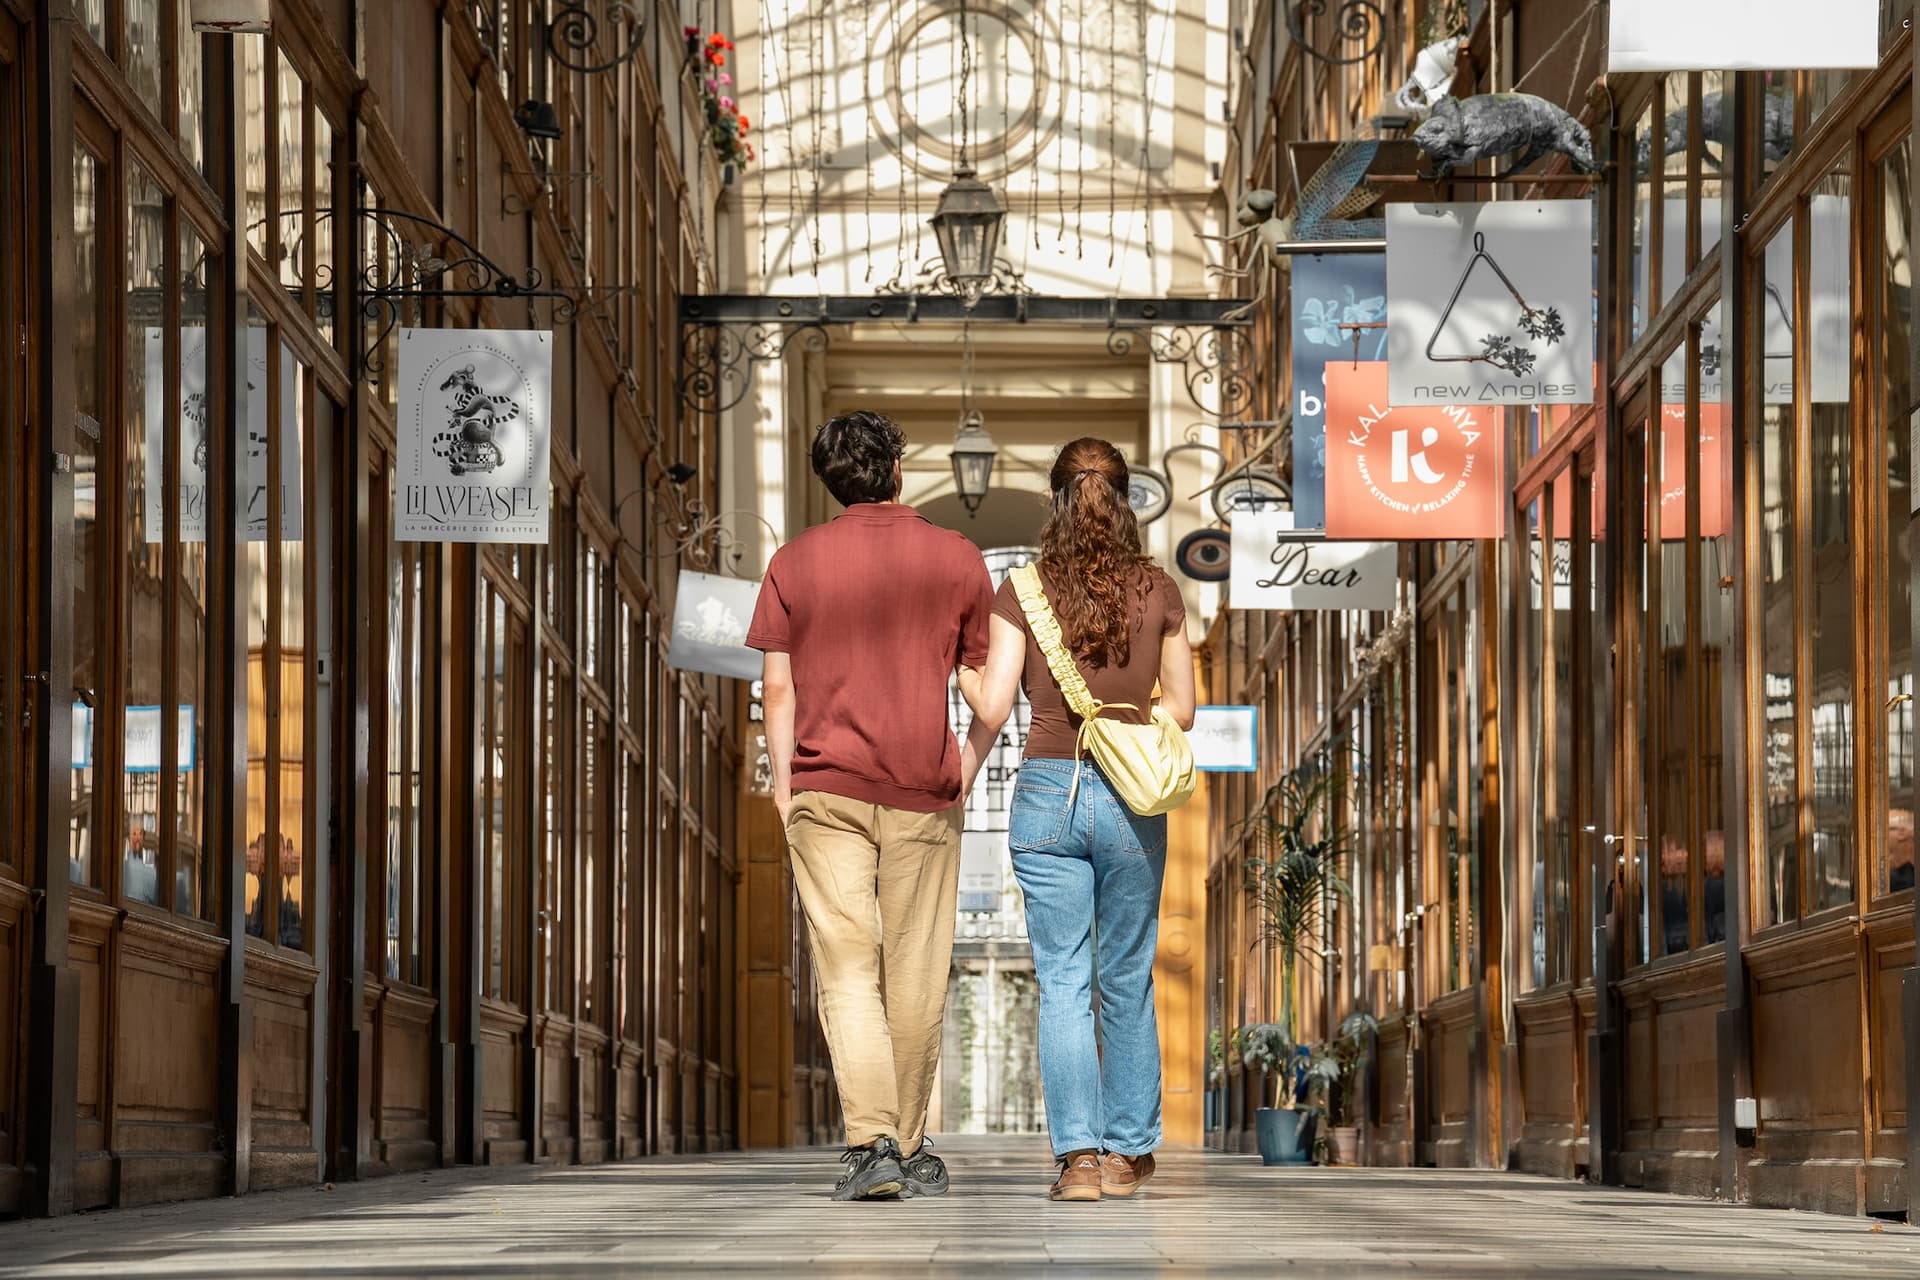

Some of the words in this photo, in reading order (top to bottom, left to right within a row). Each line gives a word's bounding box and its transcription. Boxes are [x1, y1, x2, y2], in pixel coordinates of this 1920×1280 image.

[1414, 385, 1471, 398] new
[1478, 381, 1577, 400] Angles
[1357, 454, 1373, 485] HAPPY
[1370, 485, 1410, 512] KITCHEN
[1422, 479, 1467, 512] RELAXING
[1461, 454, 1475, 478] TIME
[1256, 541, 1363, 588] Dear
